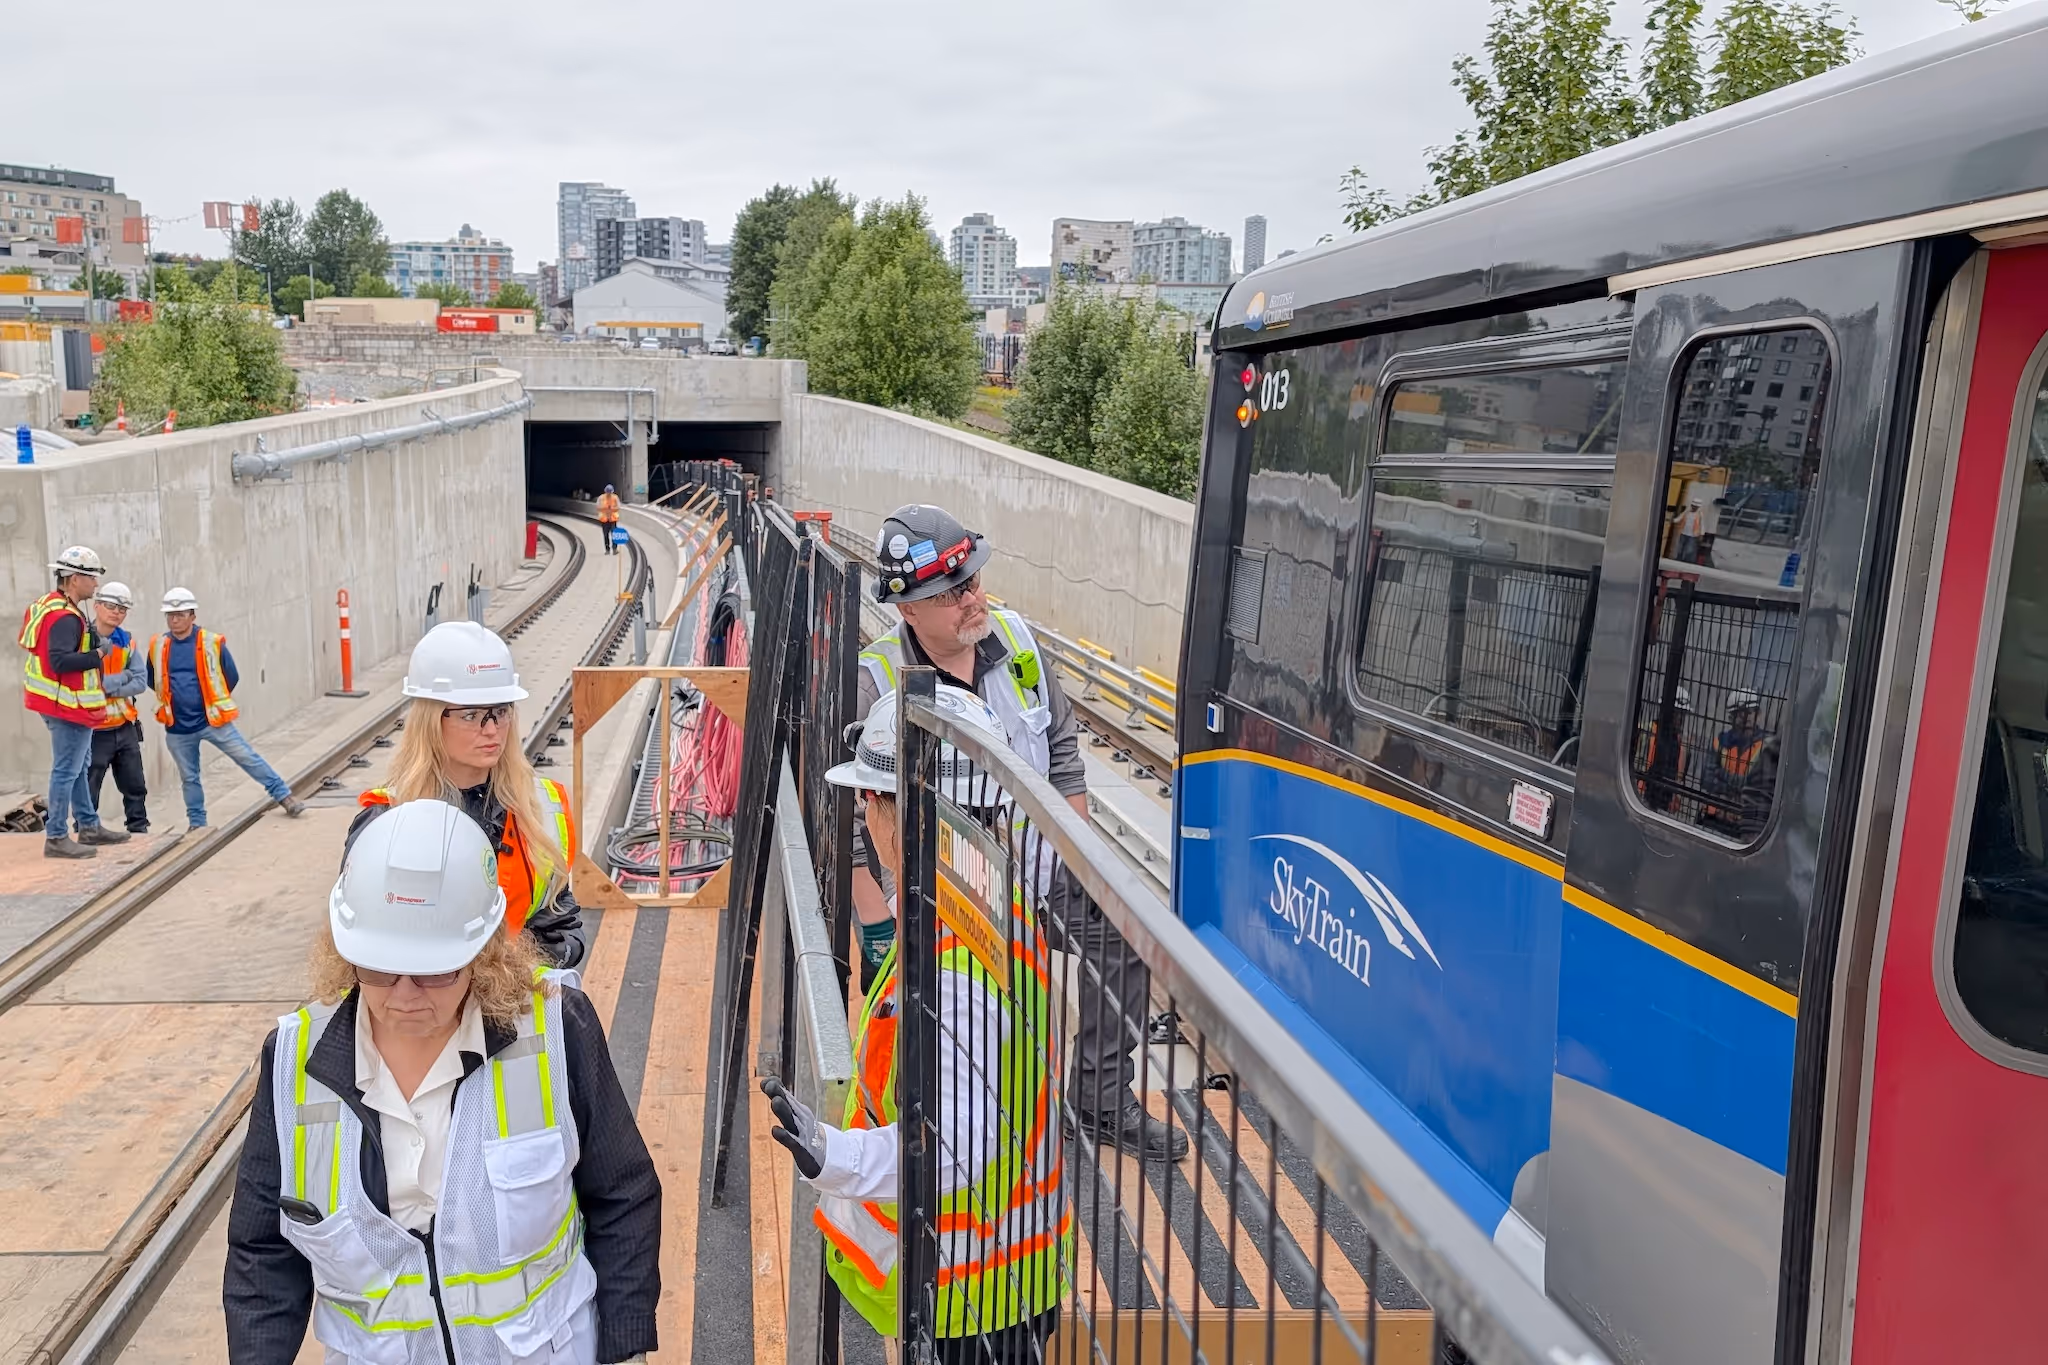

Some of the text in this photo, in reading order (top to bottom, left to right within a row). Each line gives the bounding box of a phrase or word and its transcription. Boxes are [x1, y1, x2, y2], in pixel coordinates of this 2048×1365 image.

[1261, 368, 1290, 412] 013
[952, 829, 1003, 921] MODU-LOC
[1270, 856, 1371, 988] SkyTrain
